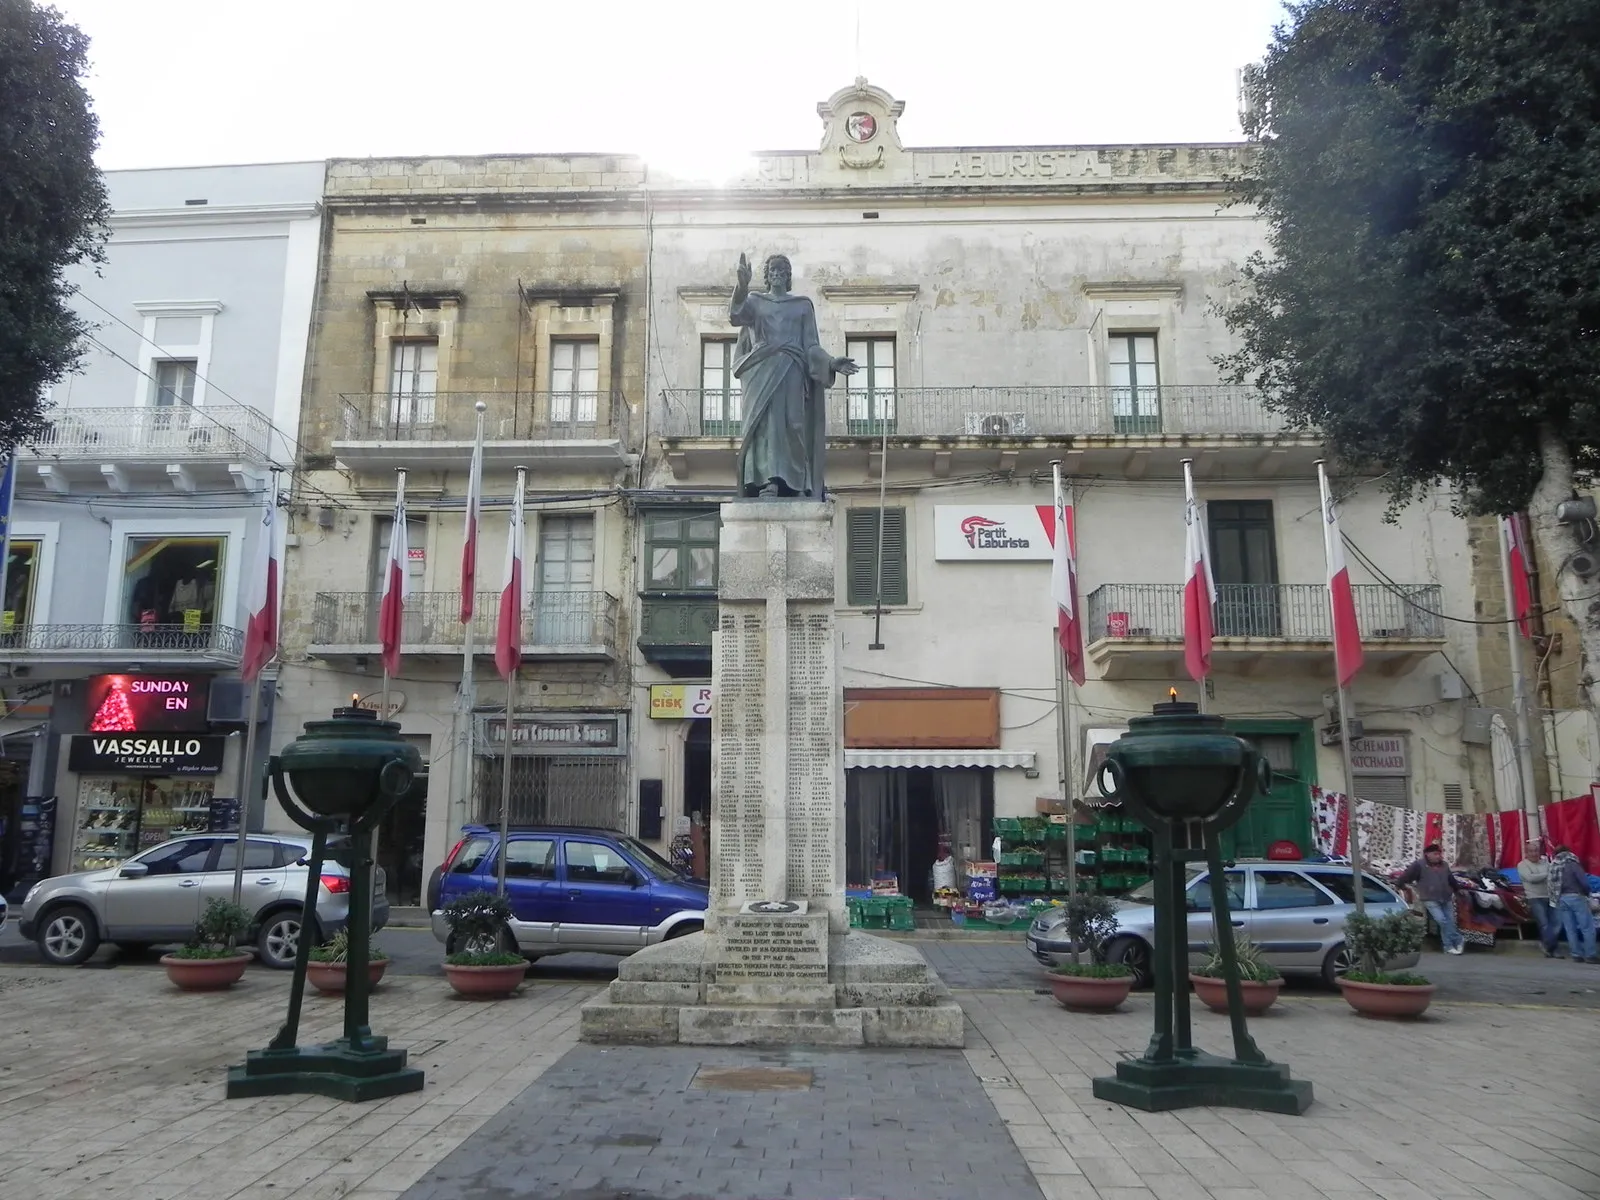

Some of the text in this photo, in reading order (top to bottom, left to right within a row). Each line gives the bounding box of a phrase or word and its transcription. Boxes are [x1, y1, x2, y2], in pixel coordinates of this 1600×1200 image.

[929, 152, 1098, 178] LABURISTA
[978, 527, 1007, 539] Partit
[978, 538, 1030, 549] Laburista
[131, 681, 189, 693] SUNDAY
[165, 697, 188, 710] EN
[653, 698, 683, 709] CISK
[92, 739, 201, 756] VASSALLO
[1350, 740, 1400, 752] SCHEMBRI
[144, 832, 163, 842] OPEN
